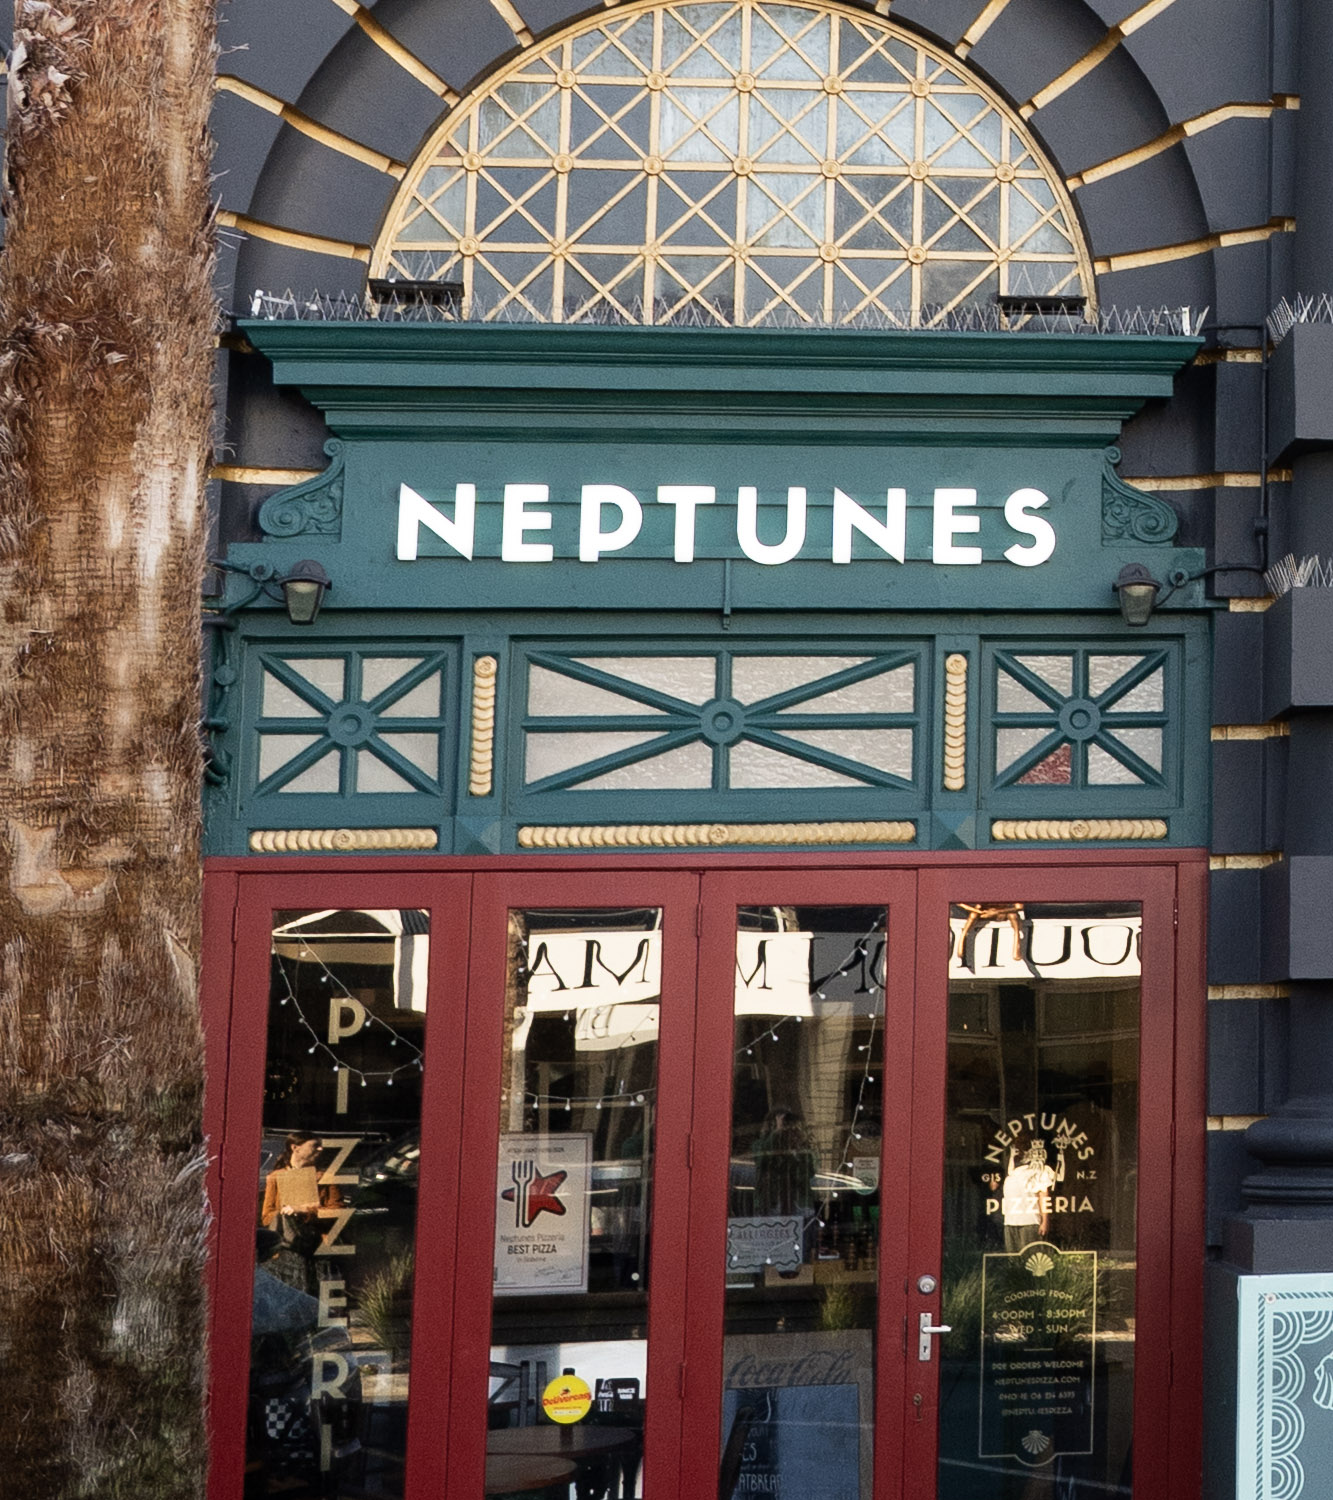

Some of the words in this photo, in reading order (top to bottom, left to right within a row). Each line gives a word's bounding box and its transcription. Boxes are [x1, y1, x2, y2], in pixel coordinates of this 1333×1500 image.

[397, 481, 1056, 567] NEPTUNES
[984, 1112, 1094, 1163] NEPTUNES
[981, 1173, 1001, 1182] GIS
[1076, 1171, 1097, 1180] N.Z
[986, 1196, 1094, 1215] PIZZERIA
[507, 1245, 530, 1255] BEST
[532, 1244, 557, 1254] PIZZA
[1004, 1289, 1046, 1303] COOKING
[1049, 1289, 1074, 1302] FROM
[1045, 1325, 1068, 1334] SUN
[1043, 1360, 1084, 1369] WELCOME
